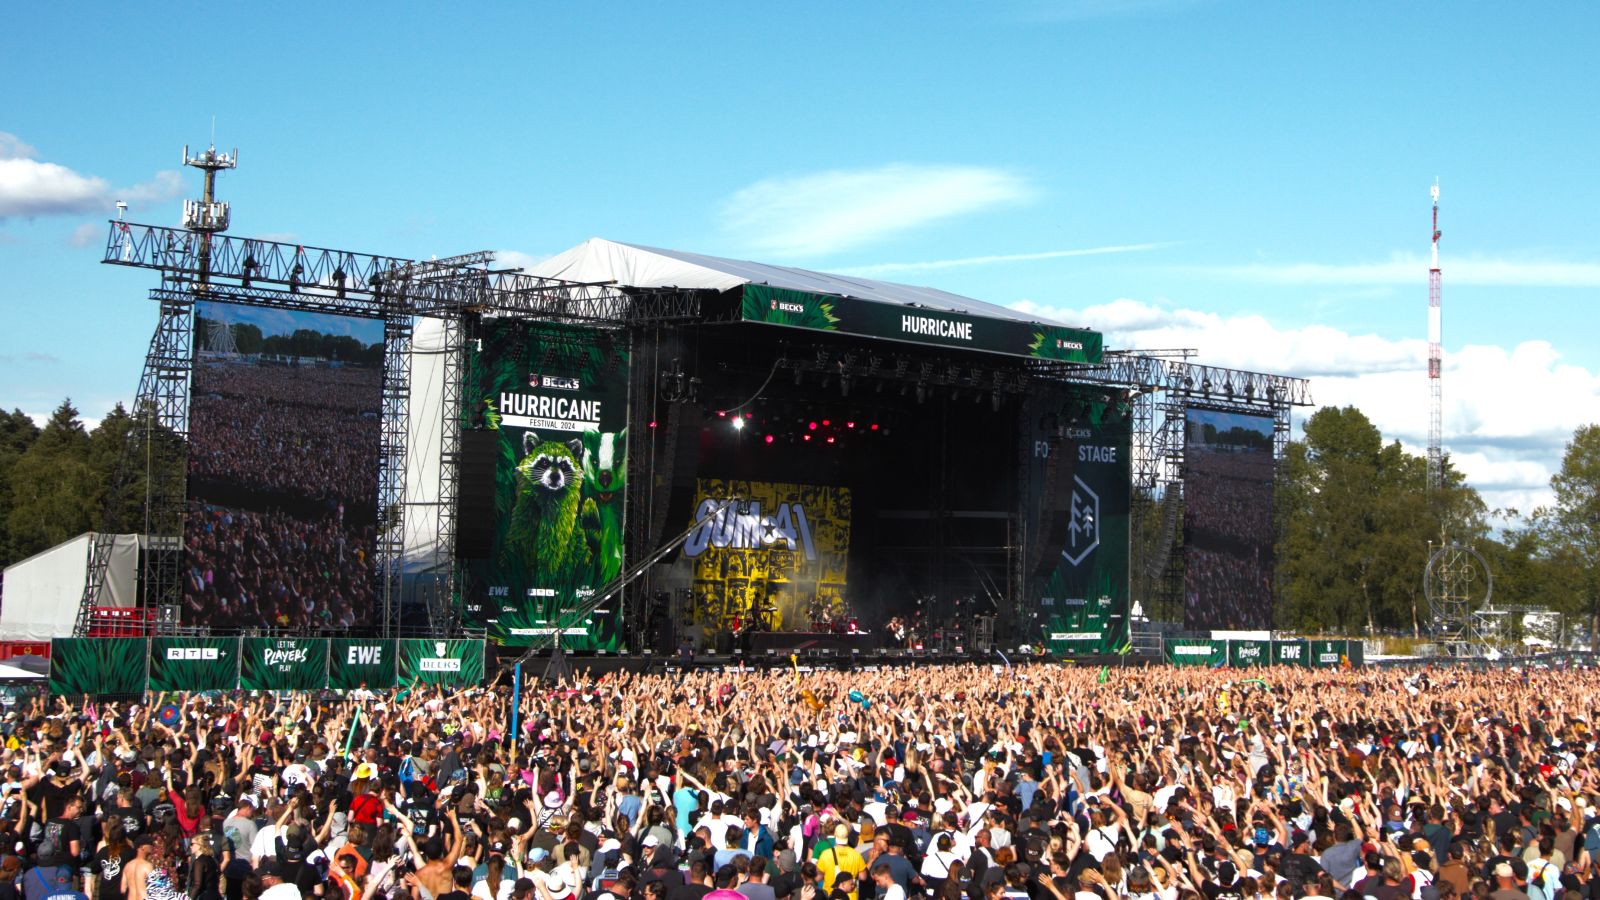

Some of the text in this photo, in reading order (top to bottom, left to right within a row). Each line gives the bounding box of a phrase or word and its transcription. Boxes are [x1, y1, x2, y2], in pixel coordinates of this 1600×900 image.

[779, 303, 804, 313] BECK'S
[902, 315, 973, 340] HURRICANE
[1063, 341, 1083, 350] BECK'S
[542, 377, 580, 390] BECK'S
[501, 392, 602, 422] HURRICANE
[529, 418, 576, 430] FESTIVAL 2024
[1078, 445, 1117, 463] STAGE
[776, 502, 818, 562] 41
[488, 586, 509, 596] EWE
[277, 641, 296, 649] LET THE
[168, 648, 228, 659] RTL+
[264, 648, 308, 666] PLAYERS
[347, 646, 382, 665] EWE
[1280, 645, 1302, 659] EWE
